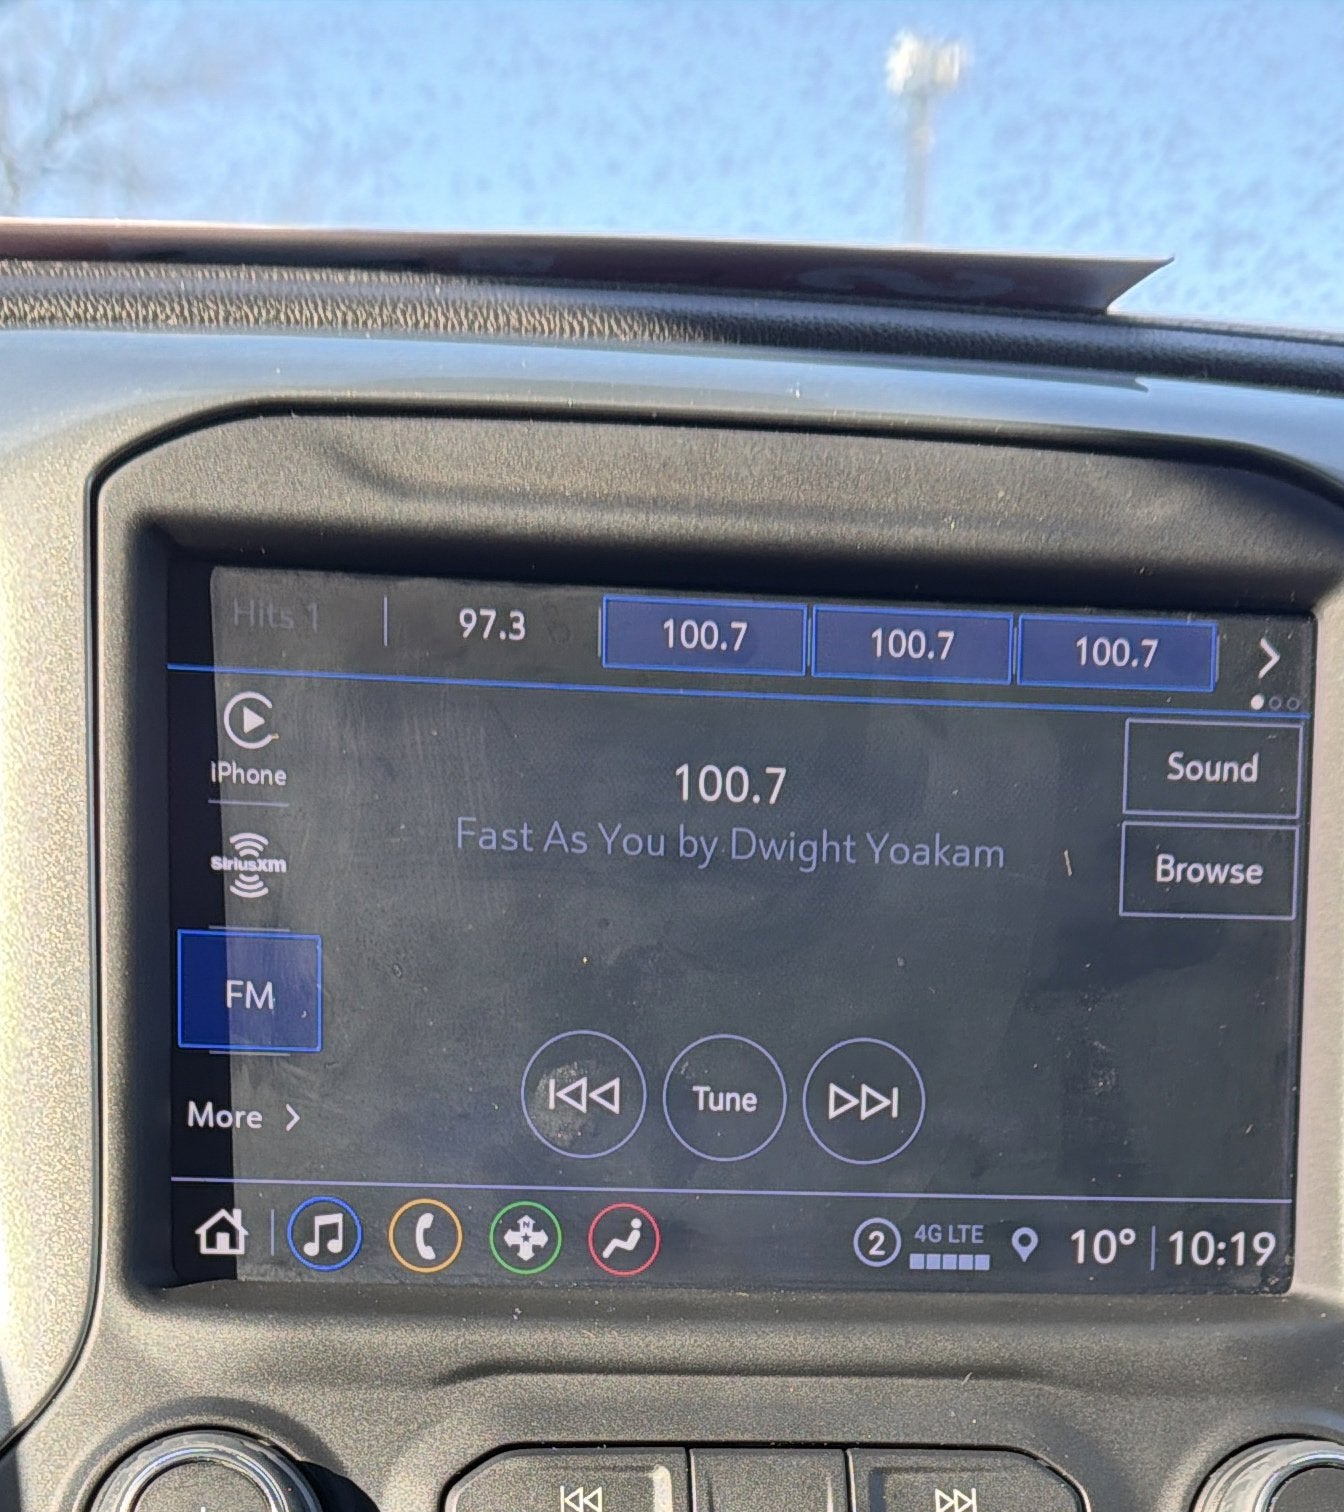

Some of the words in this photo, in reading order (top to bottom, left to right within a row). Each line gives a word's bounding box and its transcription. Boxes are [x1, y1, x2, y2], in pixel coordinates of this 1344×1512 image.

[458, 608, 526, 641] 97.3
[663, 618, 748, 652] 100.7
[871, 627, 955, 660] 100.7
[1076, 636, 1159, 669] 100.7
[210, 761, 288, 787] iPhone
[675, 763, 787, 804] 100.7
[1167, 751, 1259, 784] Sound
[457, 816, 533, 852] Fast
[543, 820, 588, 854] As
[598, 822, 664, 856] You
[679, 823, 719, 869] by
[731, 827, 856, 873] Dwight
[865, 831, 1005, 868] Yoakam
[1155, 854, 1264, 887] Browse
[225, 980, 275, 1010] FM
[692, 1086, 758, 1112] Tune
[187, 1103, 264, 1129] More
[867, 1233, 886, 1256] 2
[914, 1224, 943, 1244] 4G
[949, 1225, 984, 1245] LTE
[1069, 1228, 1136, 1265] 10°
[1167, 1231, 1276, 1267] 10:19
